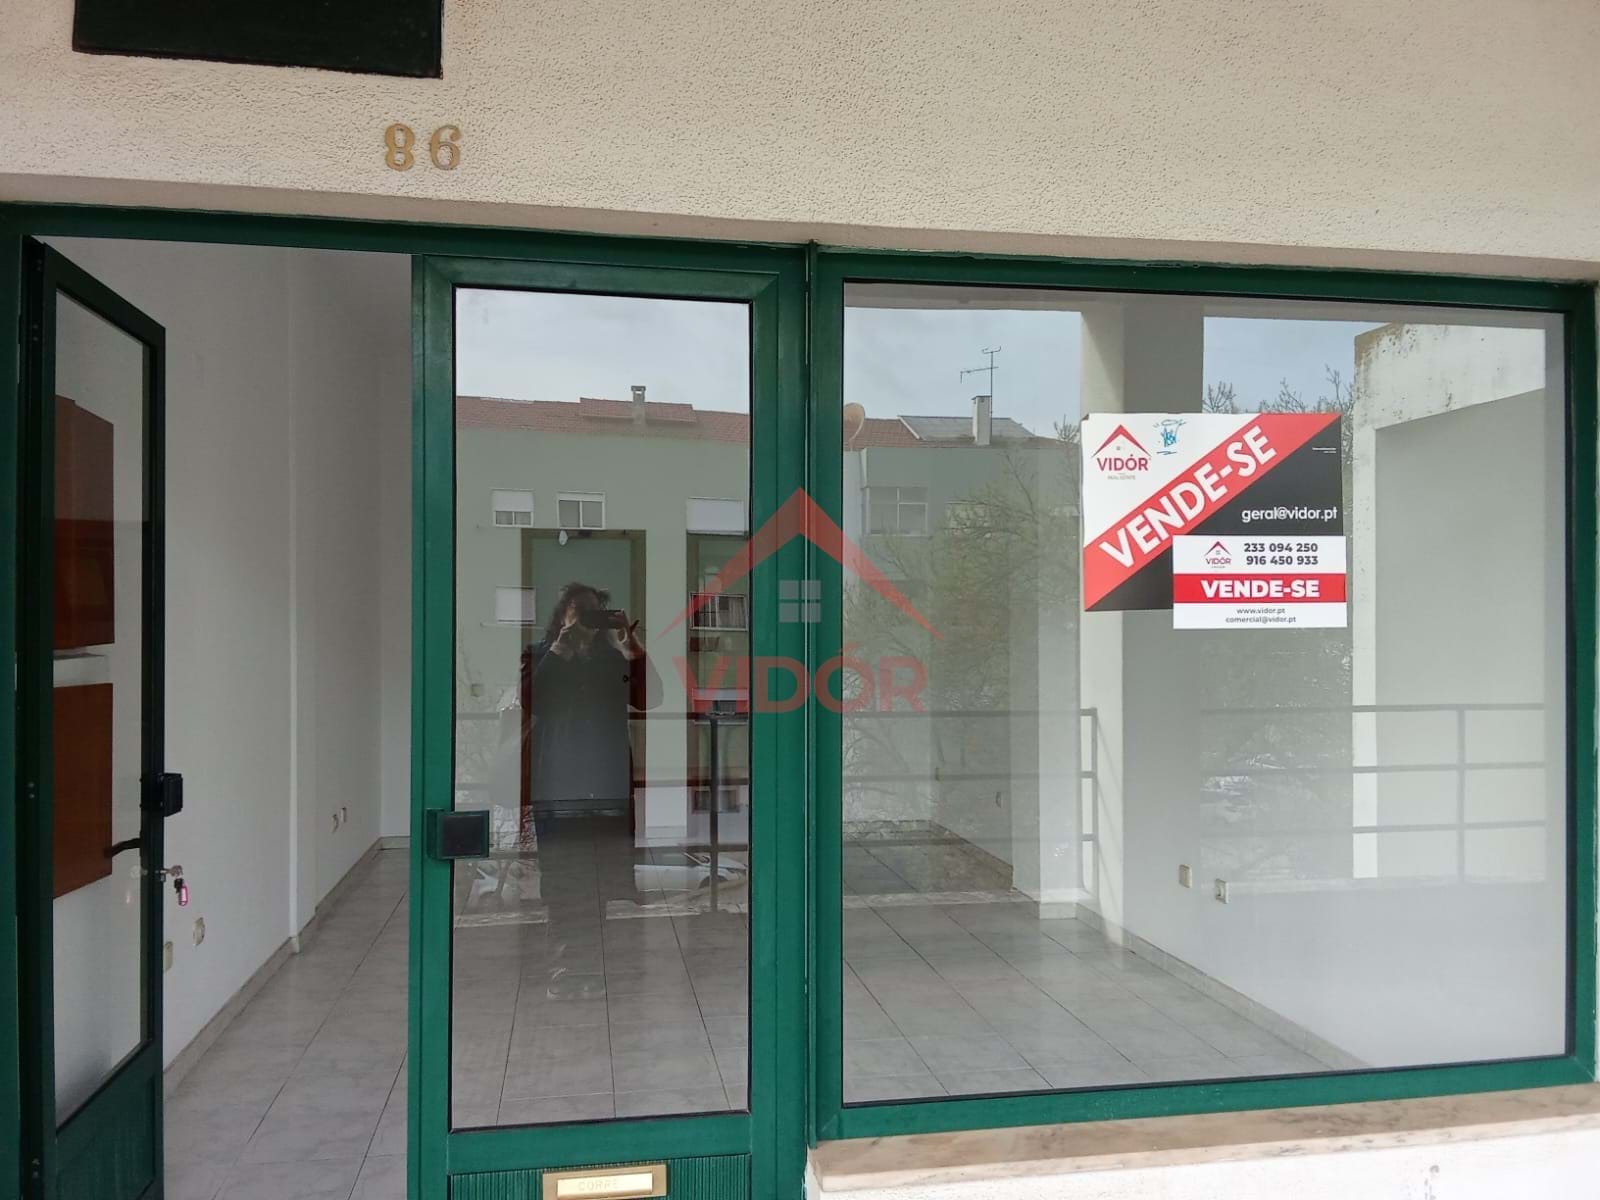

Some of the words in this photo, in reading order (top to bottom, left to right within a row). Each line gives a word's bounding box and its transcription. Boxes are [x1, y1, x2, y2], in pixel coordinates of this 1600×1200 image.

[384, 123, 461, 171] 86
[1100, 426, 1277, 568] VENDE-SE
[1241, 506, 1338, 523] geral@vidor.pt
[1244, 543, 1265, 552] 233
[1269, 543, 1293, 552] 094
[1296, 543, 1318, 552] 250
[1246, 556, 1267, 565] 916
[1270, 556, 1293, 565] 450
[1297, 556, 1319, 565] 933
[1201, 580, 1320, 598] VENDE-SE
[1225, 616, 1296, 624] comercial@vidor.pt
